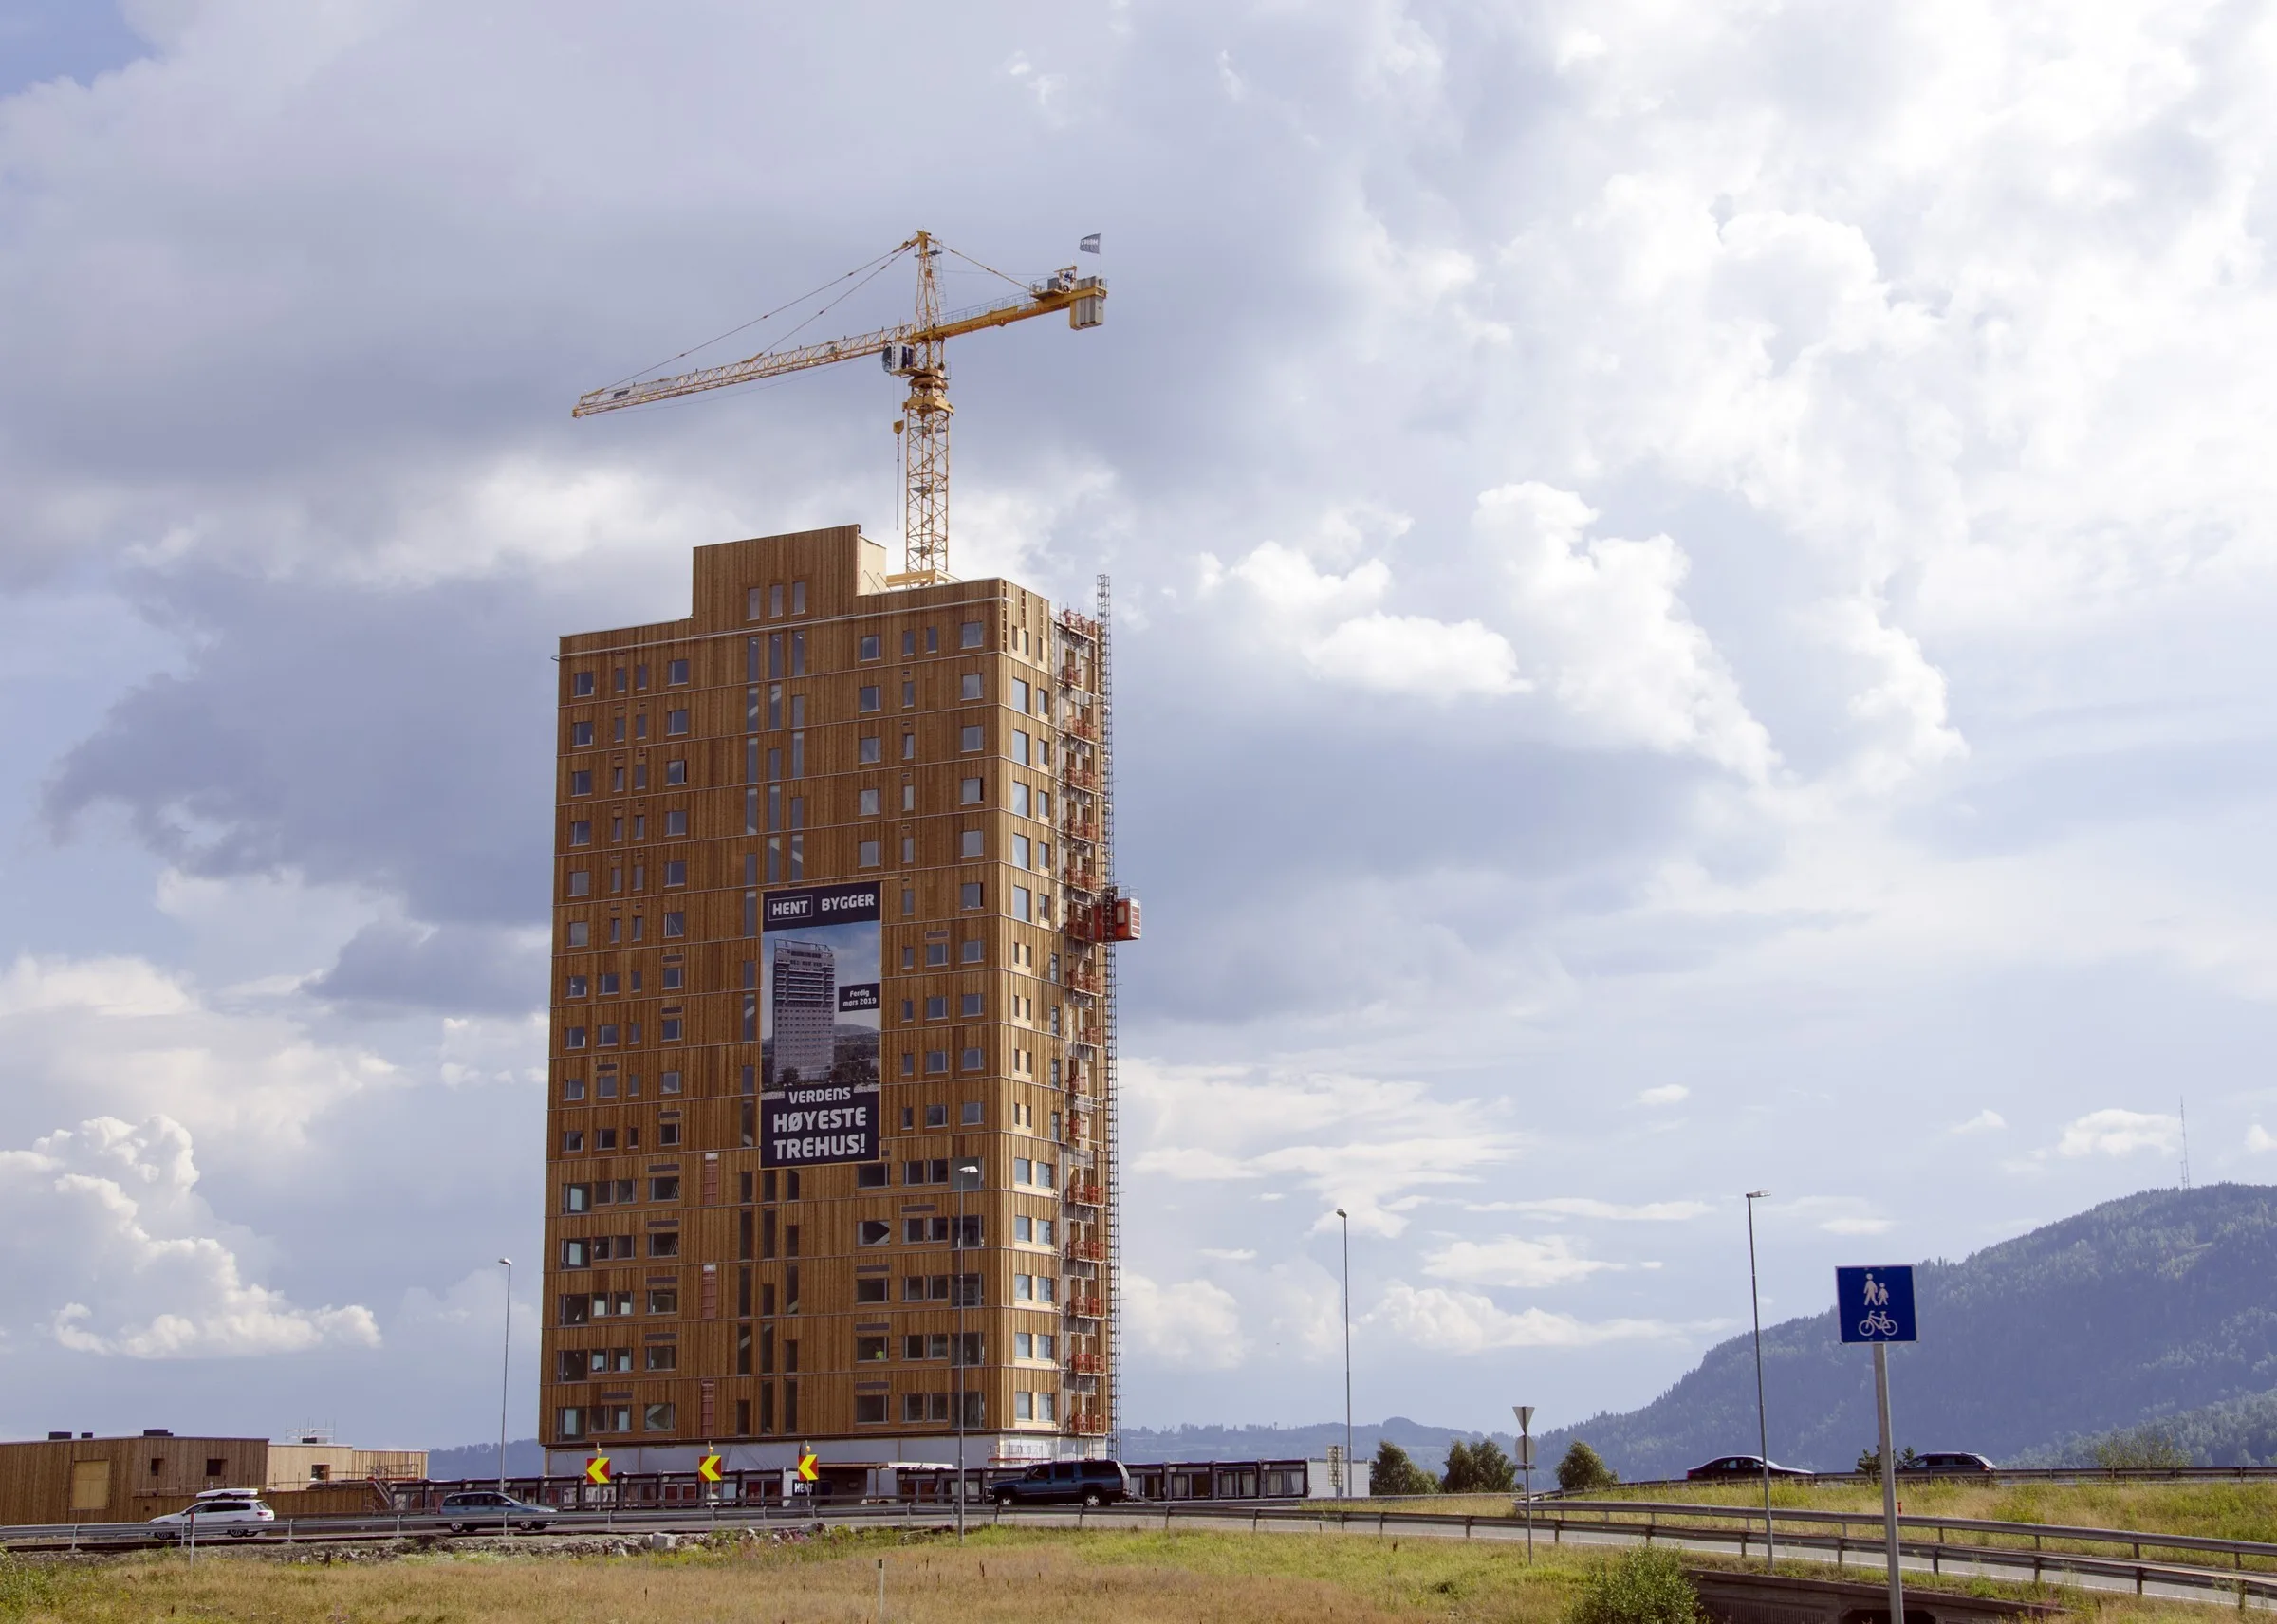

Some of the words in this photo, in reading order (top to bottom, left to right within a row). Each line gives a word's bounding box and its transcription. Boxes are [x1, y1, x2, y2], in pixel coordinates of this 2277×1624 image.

[772, 900, 808, 915] HENT
[821, 894, 874, 911] BYGGER
[849, 988, 870, 997] Ferdig
[860, 997, 877, 1006] 2019
[788, 1087, 851, 1104] VERDENS
[773, 1106, 866, 1133] HØYESTE
[773, 1133, 865, 1160] TREHUS!
[794, 1482, 814, 1493] HENT
